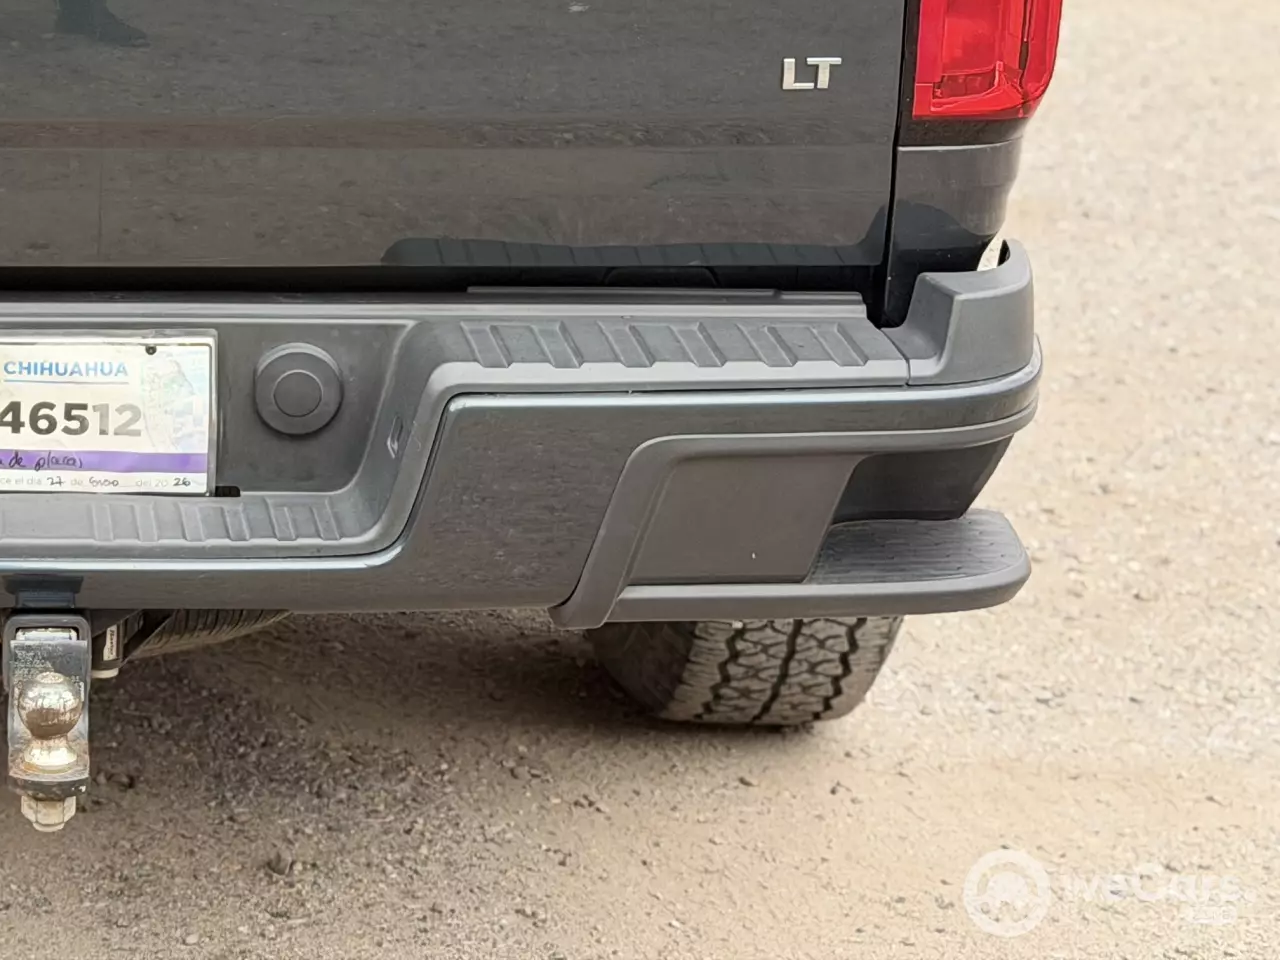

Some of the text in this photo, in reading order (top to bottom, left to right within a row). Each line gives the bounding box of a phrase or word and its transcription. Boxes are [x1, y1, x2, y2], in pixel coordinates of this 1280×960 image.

[782, 57, 842, 90] LT
[3, 361, 129, 377] CHIHUAHUA
[15, 476, 24, 486] el
[173, 477, 191, 488] 26
